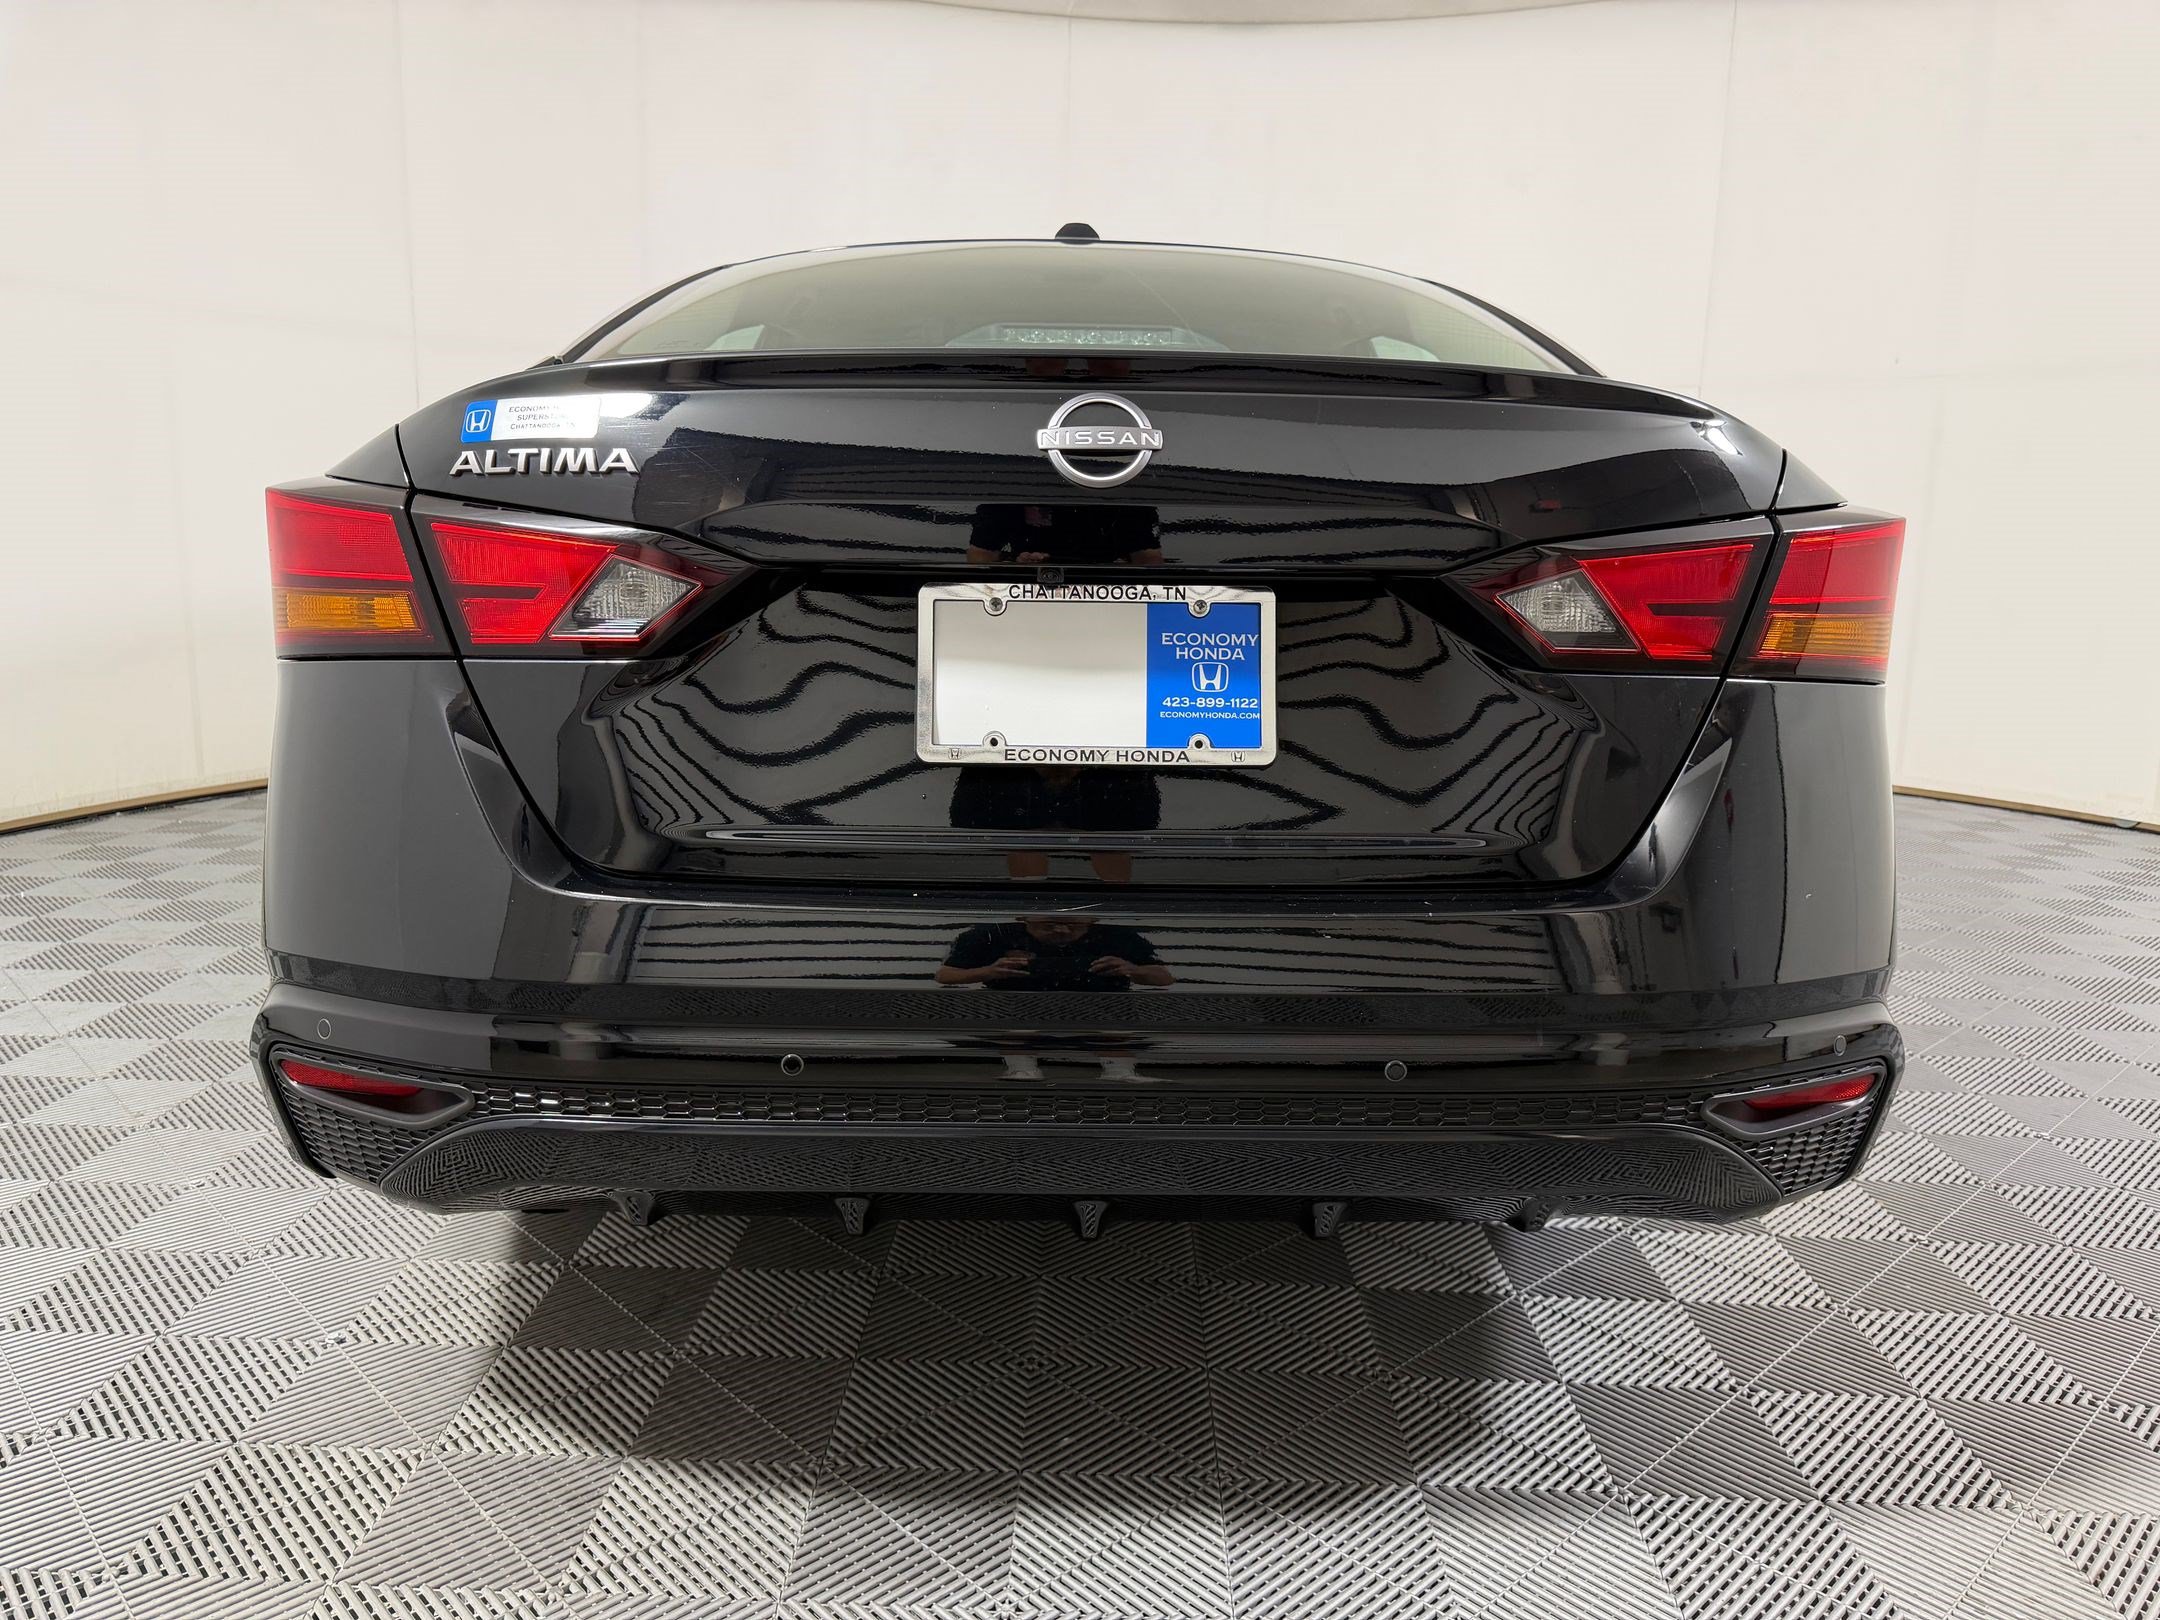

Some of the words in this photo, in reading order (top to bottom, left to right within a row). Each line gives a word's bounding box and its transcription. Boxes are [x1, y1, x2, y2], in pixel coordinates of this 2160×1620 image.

[1040, 431, 1160, 446] NISSAN
[449, 447, 640, 476] ALTIMA
[1162, 586, 1186, 601] TN
[1161, 632, 1259, 647] ECONOMY
[1175, 647, 1245, 661] HONDA
[1162, 696, 1258, 708] 423-899-1122
[1159, 711, 1260, 719] ECONOMYHONDA.COM
[1004, 748, 1110, 762] ECONOMY
[1116, 749, 1191, 763] HONDA
